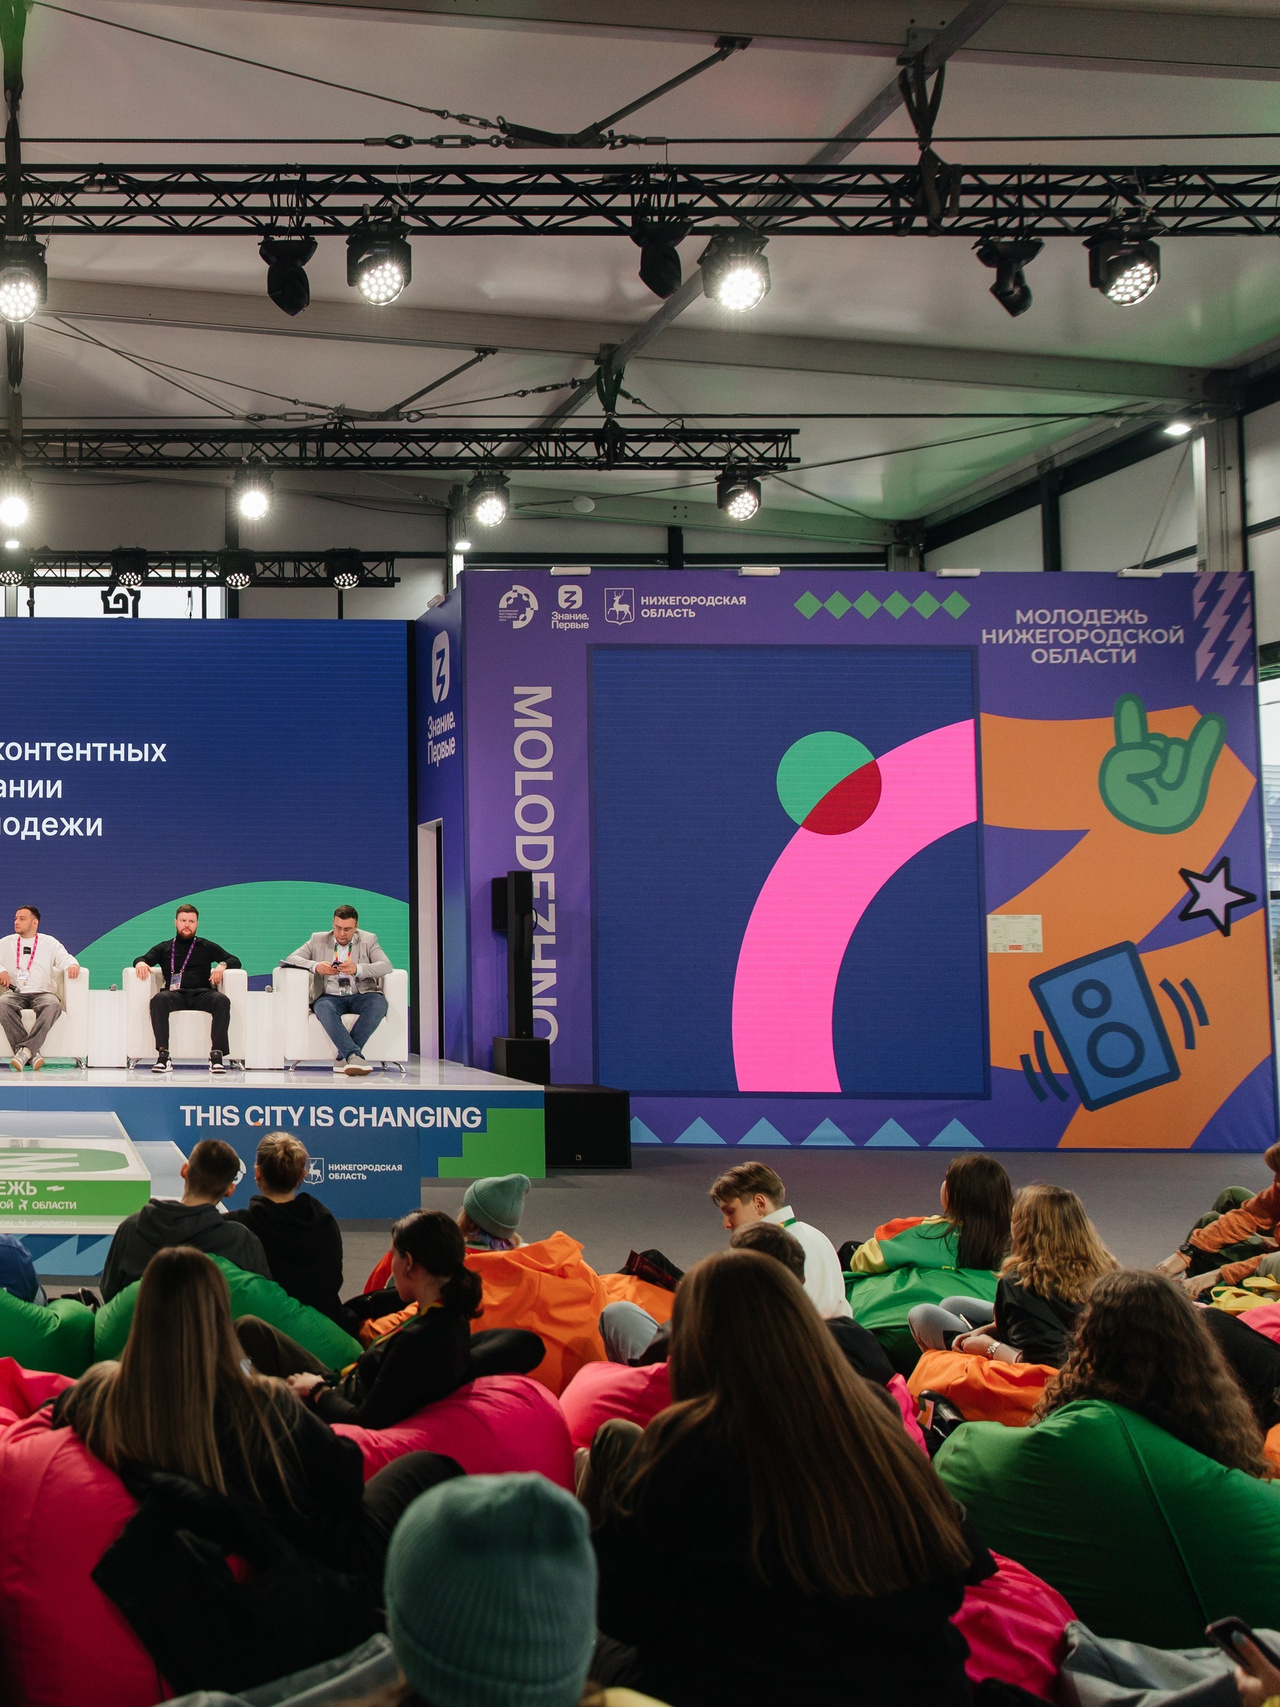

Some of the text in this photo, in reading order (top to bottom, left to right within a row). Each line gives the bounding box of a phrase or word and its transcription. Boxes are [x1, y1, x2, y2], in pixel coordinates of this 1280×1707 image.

[641, 596, 747, 607] НИЖЕГОРОДСКАЯ
[551, 611, 589, 620] Знание.
[641, 608, 696, 618] ОБЛАСТЬ
[1015, 609, 1149, 627] МОЛОДЕЖЬ
[551, 620, 589, 631] Первые
[981, 625, 1185, 647] НИЖЕГОРОДСКОЙ
[1031, 648, 1138, 664] ОБЛАСТИ
[427, 736, 456, 767] Первые
[180, 1105, 482, 1128] THIS CITY IS CHANGING
[328, 1163, 403, 1172] НИЖЕГОРОДСКАЯ
[328, 1172, 367, 1180] ОБЛАСТЬ
[32, 1201, 77, 1211] ОБЛАСТИ
